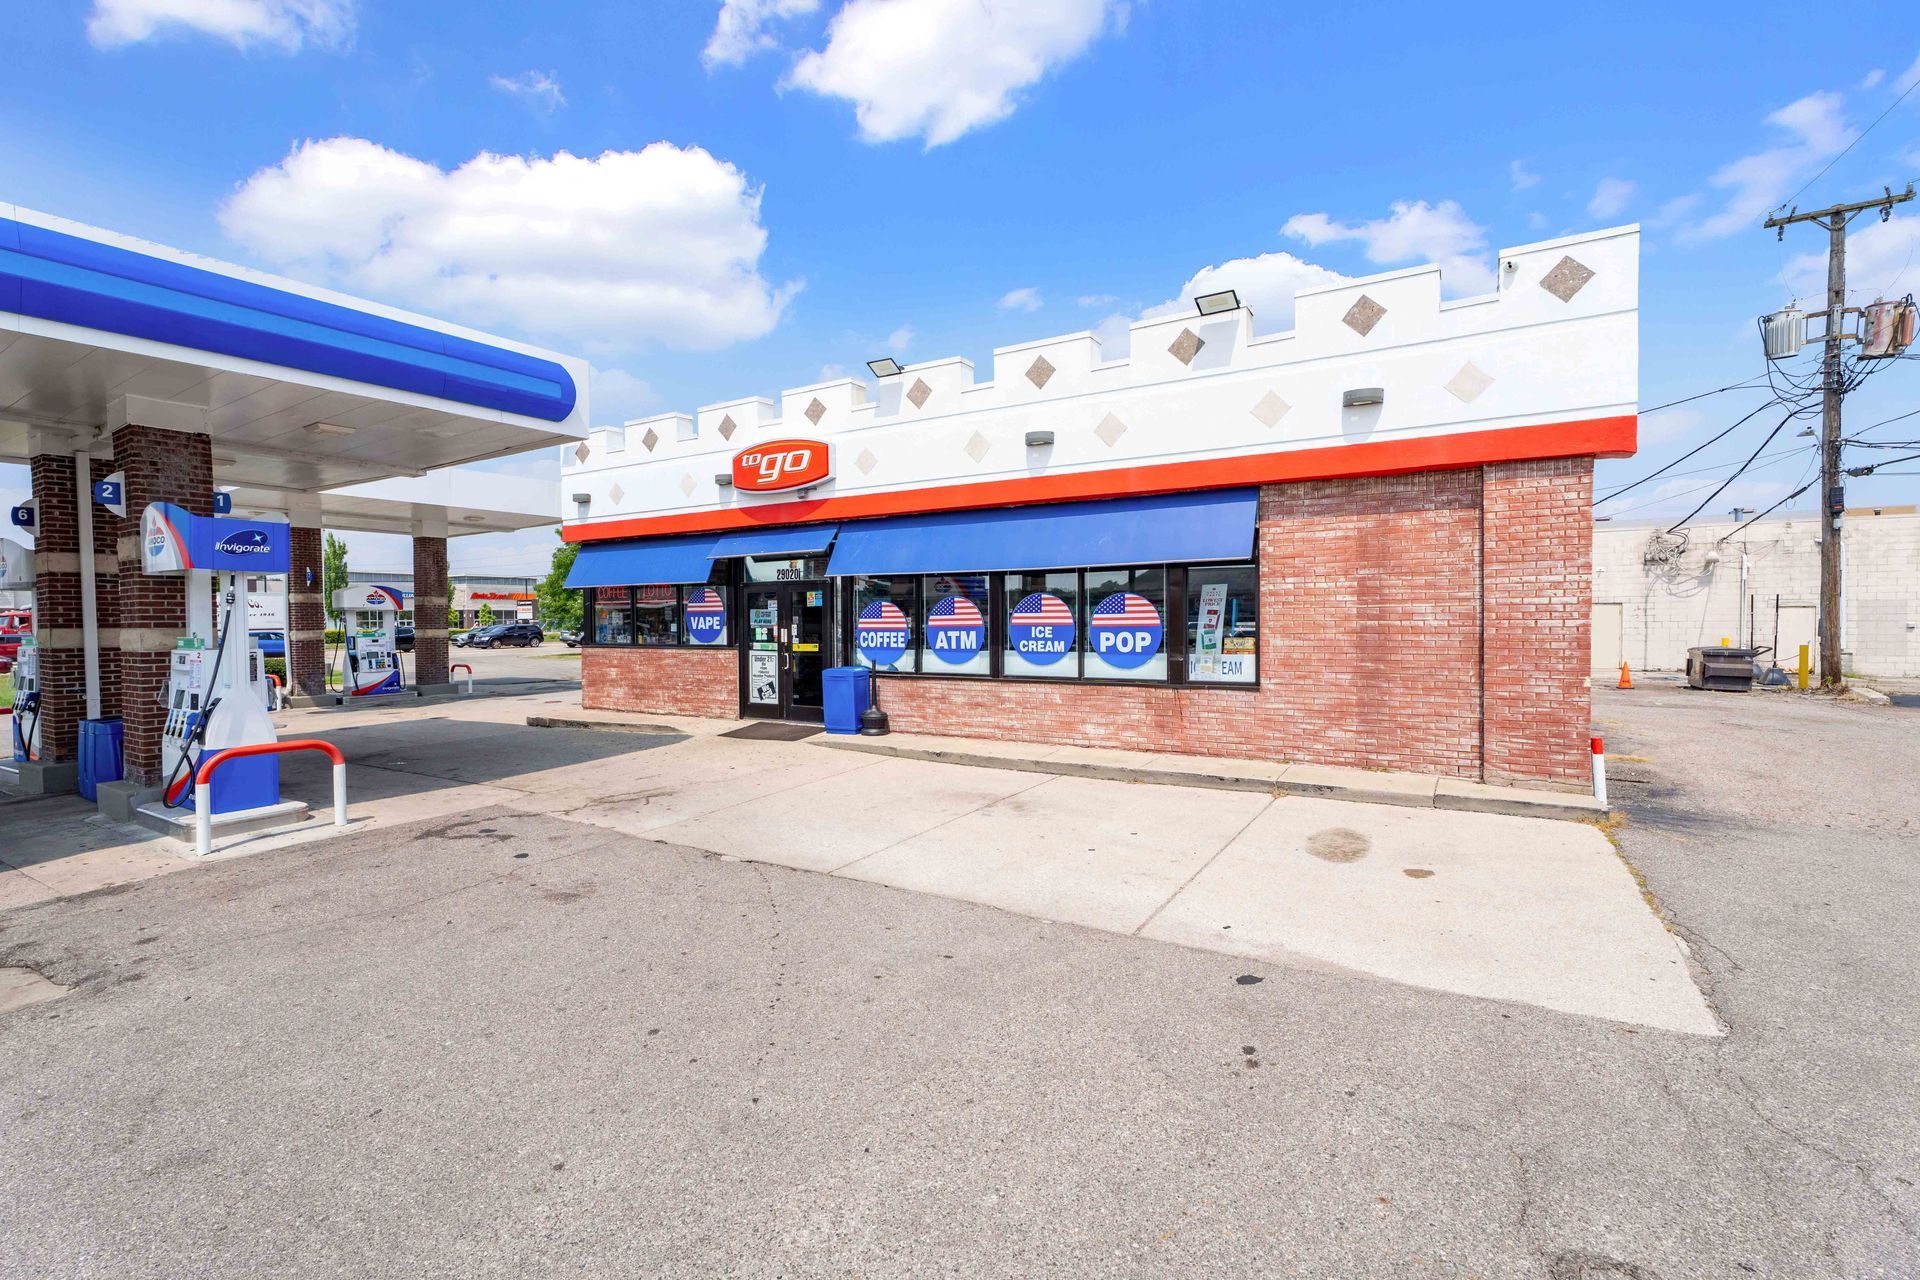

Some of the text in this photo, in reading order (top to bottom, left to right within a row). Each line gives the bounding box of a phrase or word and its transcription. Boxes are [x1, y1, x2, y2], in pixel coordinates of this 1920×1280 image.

[741, 449, 811, 483] to go
[102, 484, 113, 498] 2
[216, 495, 224, 506] 1
[18, 509, 28, 520] 6
[642, 584, 672, 597] LOTTO
[690, 616, 721, 630] VAPE
[1031, 626, 1053, 638] ICE
[859, 631, 906, 648] COFFEE
[935, 630, 977, 650] ATM
[1019, 640, 1065, 653] CREAM
[1099, 631, 1152, 654] POP
[1221, 661, 1243, 675] EAM
